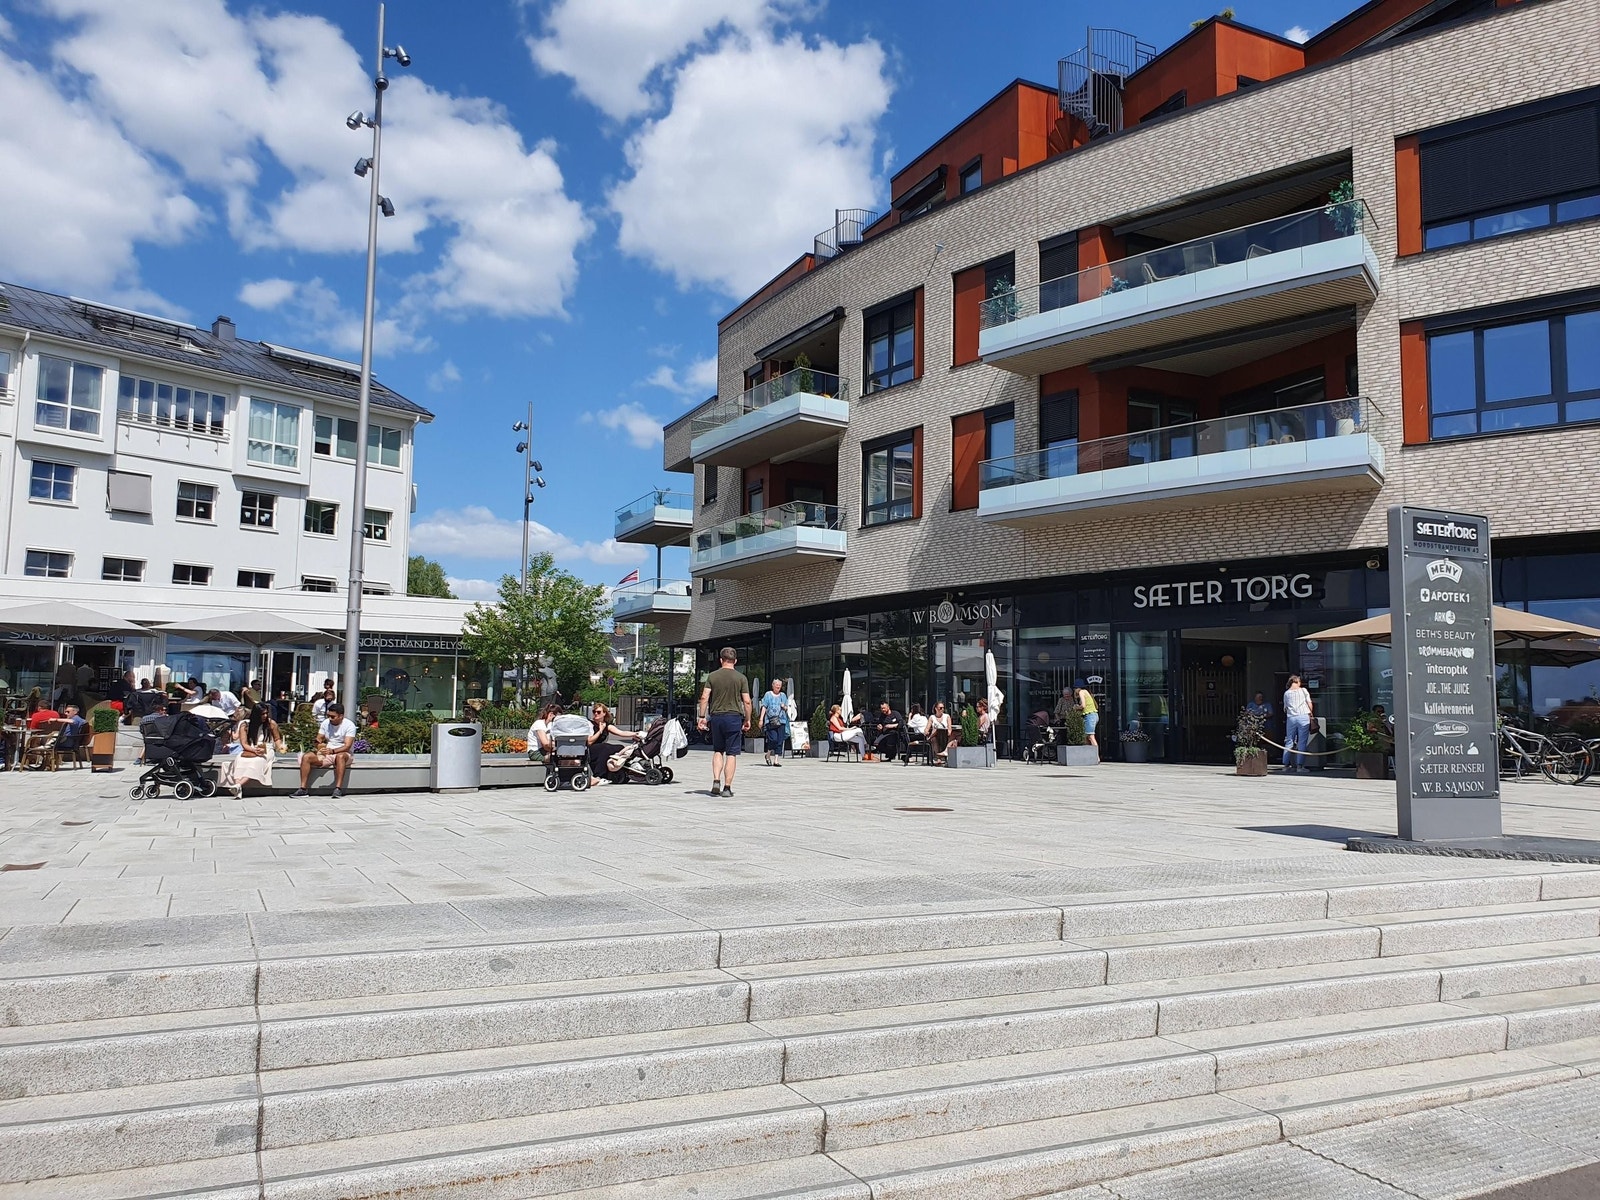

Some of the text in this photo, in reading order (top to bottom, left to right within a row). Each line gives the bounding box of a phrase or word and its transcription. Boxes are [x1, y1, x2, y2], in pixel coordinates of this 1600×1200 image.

[1430, 564, 1459, 577] MENY
[1133, 573, 1313, 608] SÆTER TORG
[955, 603, 1003, 621] MSON
[1434, 611, 1447, 622] ARK
[1416, 629, 1476, 641] BETH'S BEAUTY
[358, 638, 465, 650] NORDSTRAND BELYS
[1425, 682, 1437, 694] JOE
[1440, 682, 1451, 694] THE
[1452, 683, 1470, 695] JUICE
[1424, 702, 1474, 715] Kaffebrenneriet
[1425, 742, 1464, 755] sunkost
[1420, 763, 1485, 774] SÆTER RENSERI
[1421, 781, 1484, 793] W. B. SAMSON
